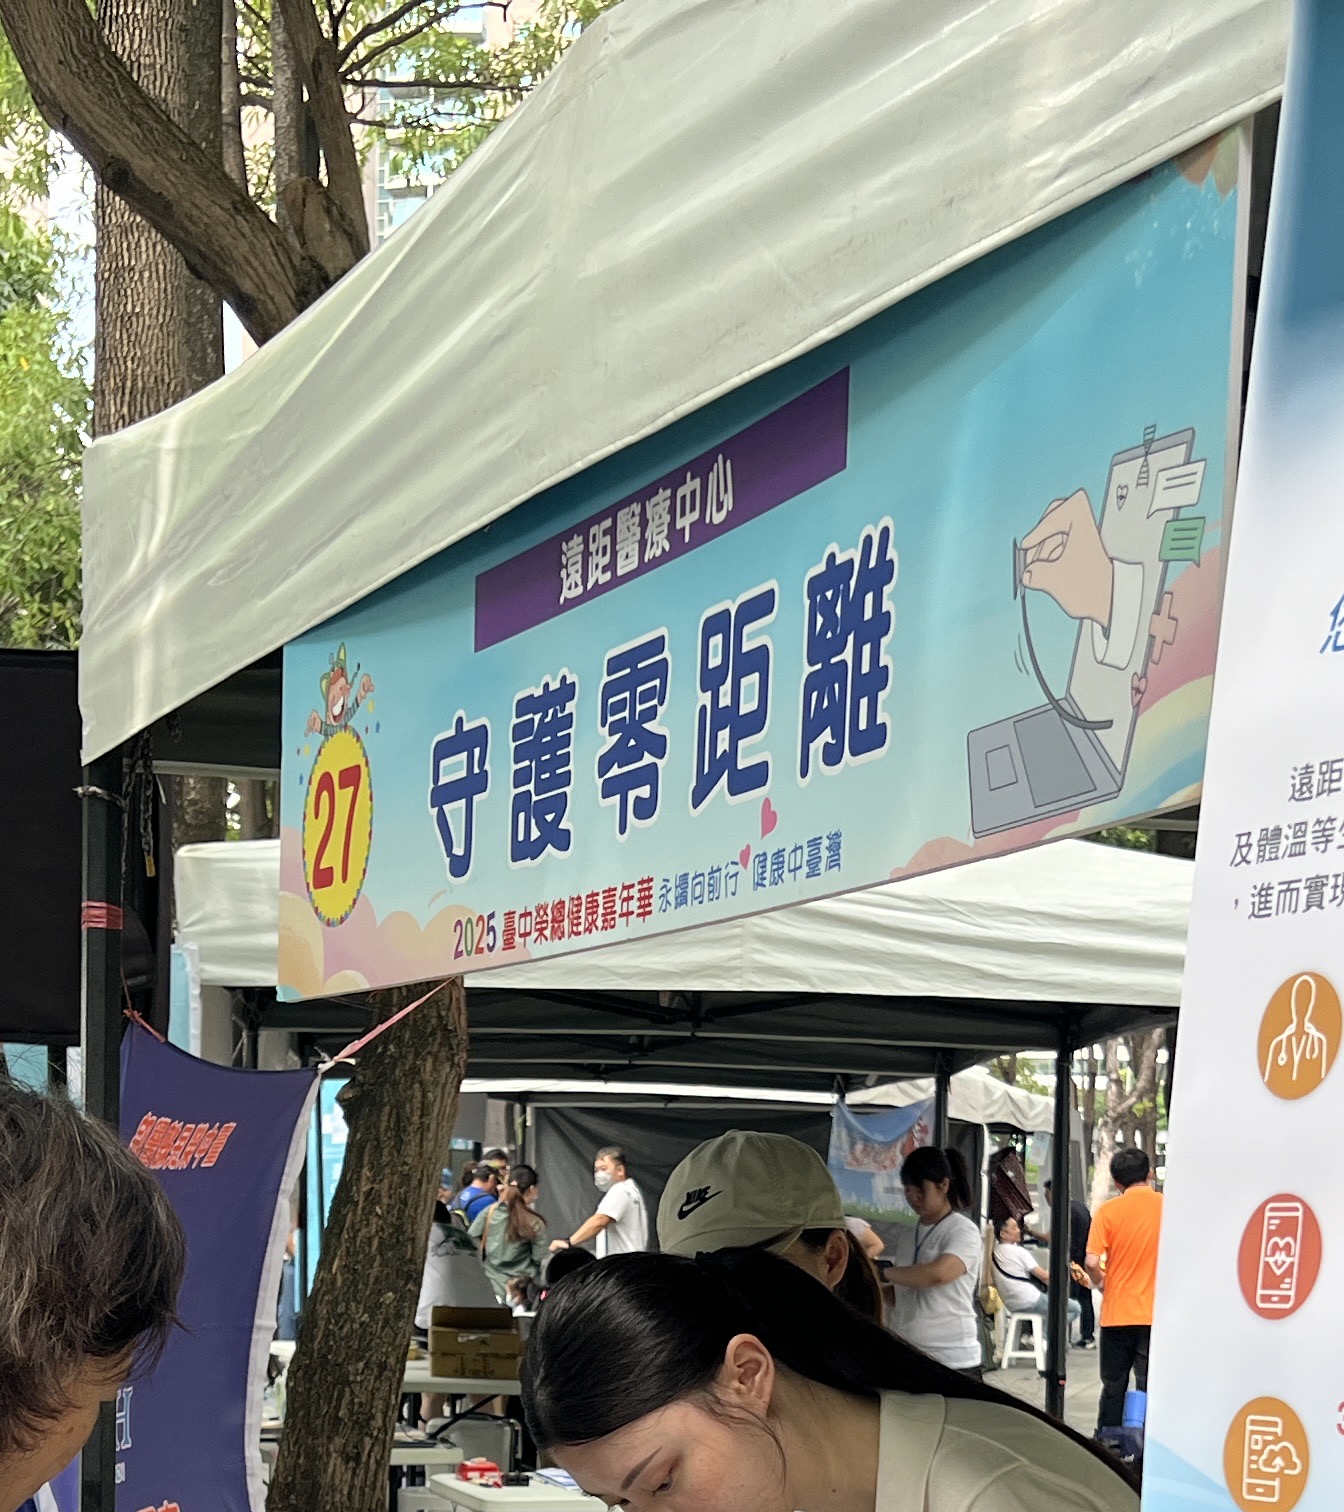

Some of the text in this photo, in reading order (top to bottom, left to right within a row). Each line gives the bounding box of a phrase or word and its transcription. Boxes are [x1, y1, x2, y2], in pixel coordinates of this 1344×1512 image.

[558, 452, 734, 605] 遠距醫療中心
[429, 527, 894, 877] 守護零距離
[315, 766, 361, 888] 27
[454, 912, 497, 960] 2025
[503, 882, 654, 952] 臺中榮總健康嘉年華
[752, 830, 842, 890] 健康中臺灣
